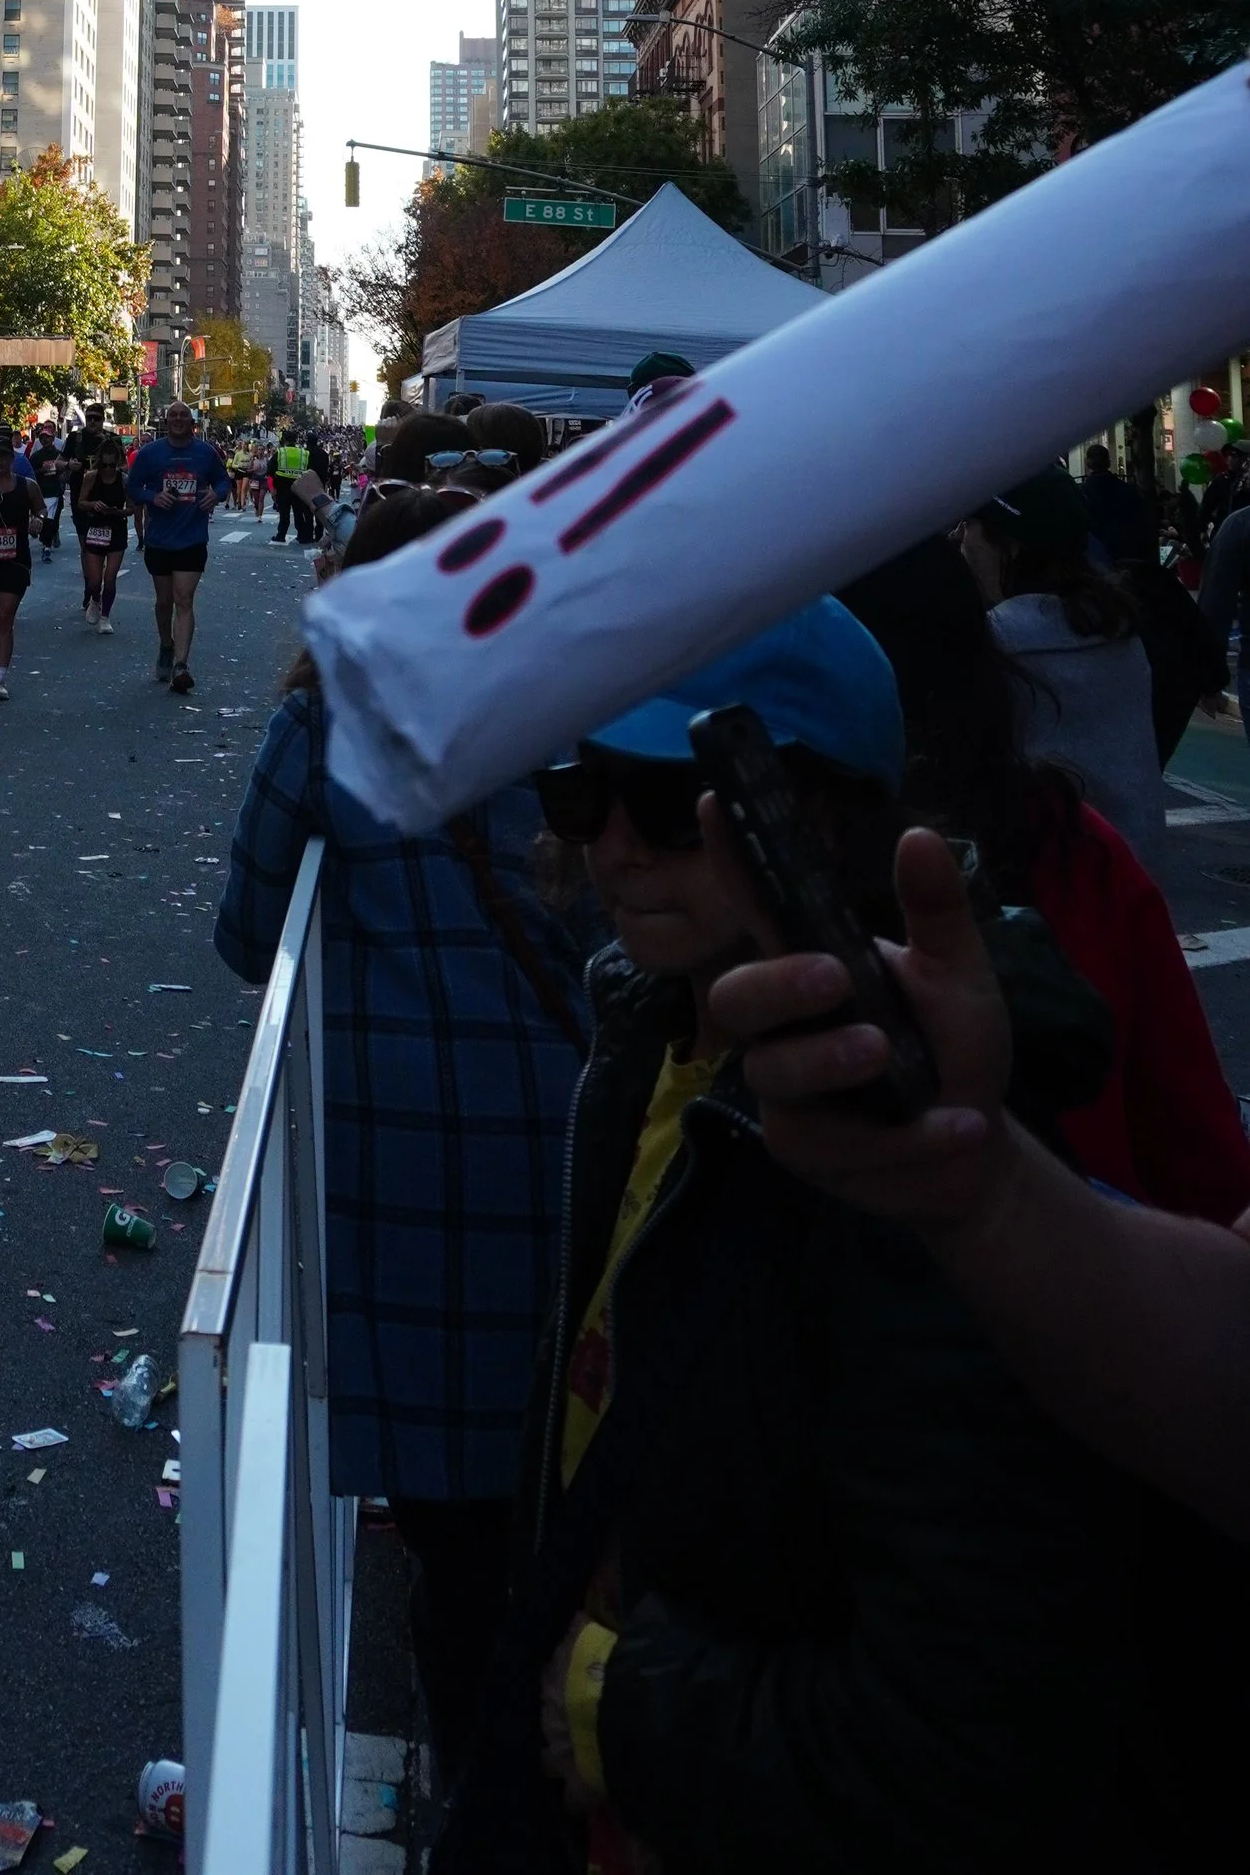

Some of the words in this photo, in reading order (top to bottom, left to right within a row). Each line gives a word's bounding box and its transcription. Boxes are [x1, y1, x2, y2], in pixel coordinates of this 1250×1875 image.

[525, 204, 536, 218] E
[542, 205, 566, 220] 88
[573, 207, 594, 221] St
[151, 1780, 184, 1803] NORTH
